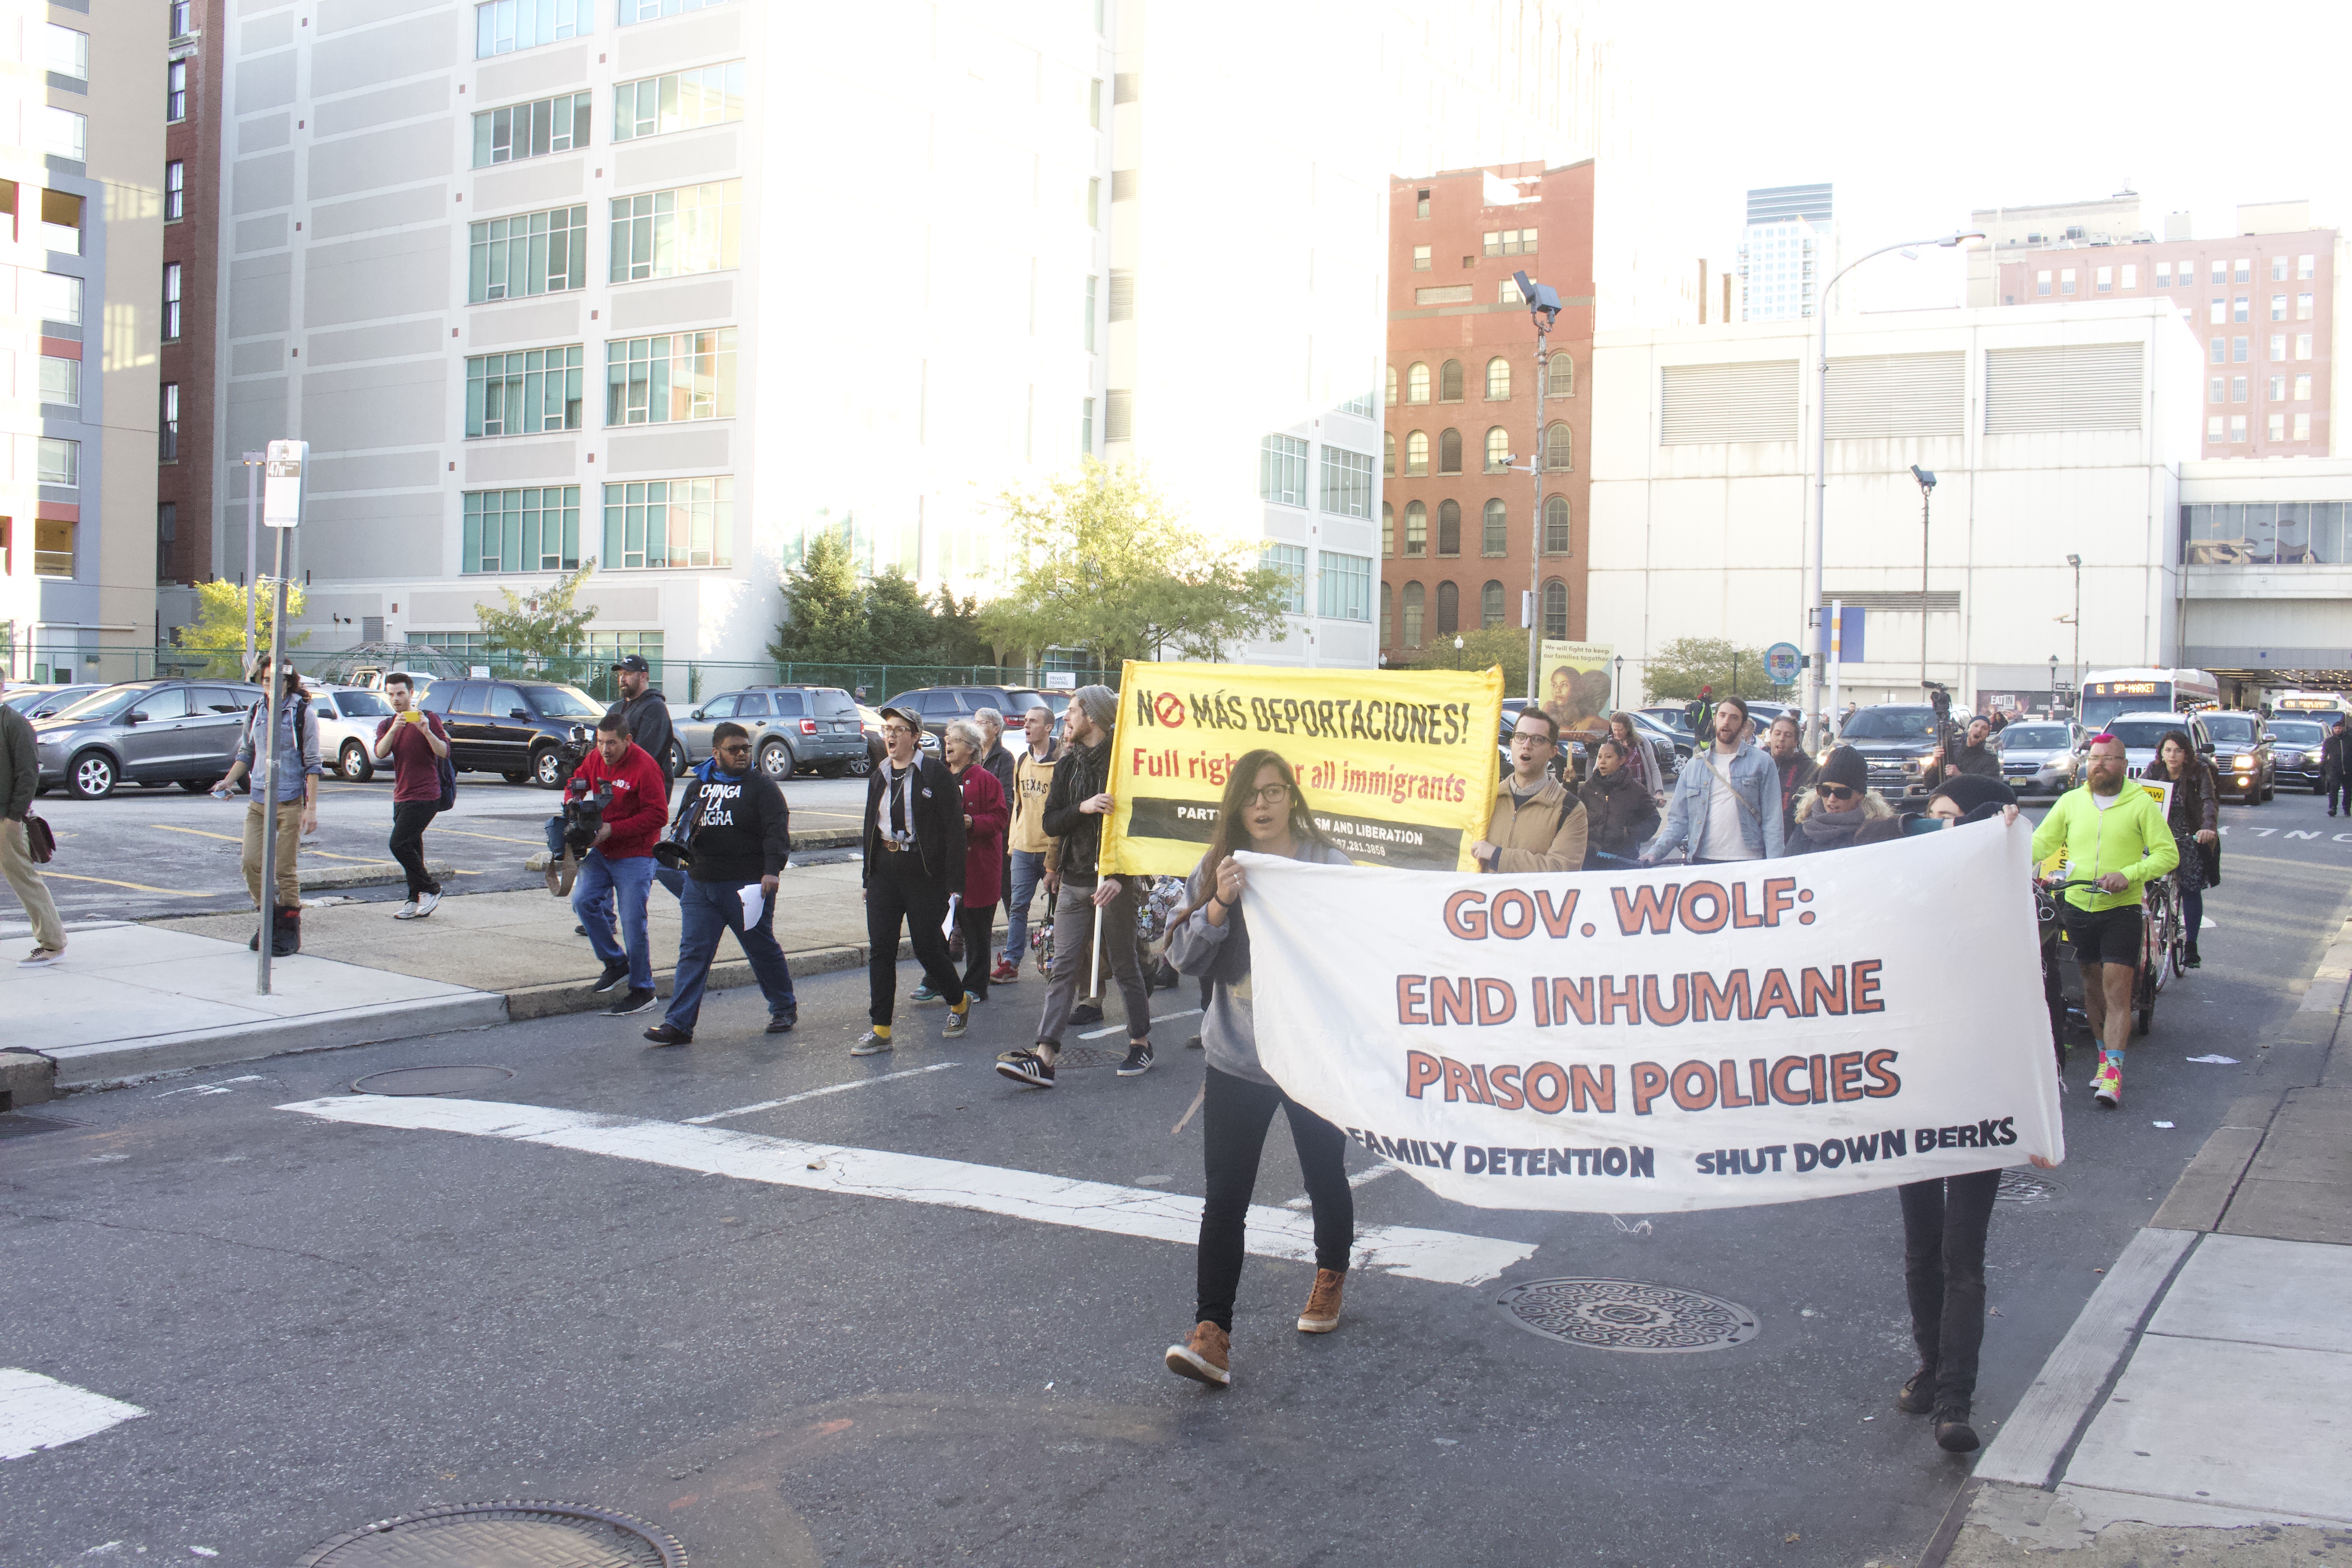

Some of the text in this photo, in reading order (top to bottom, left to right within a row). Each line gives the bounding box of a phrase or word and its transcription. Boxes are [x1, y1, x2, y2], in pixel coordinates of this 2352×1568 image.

[269, 461, 285, 476] 47M
[1991, 696, 2013, 705] EAT IN
[2096, 683, 2155, 694] 61 9TH-MARKET
[1190, 689, 1247, 730] MÁS
[1251, 697, 1470, 745] DEPORTACIONES!
[1020, 779, 1048, 794] TEXAS
[1133, 748, 1179, 777] Full
[1189, 750, 1238, 786] righ
[1311, 760, 1335, 790] all
[1341, 760, 1466, 804] immigrants
[700, 784, 741, 799] CHINGA
[706, 797, 722, 811] LA
[1333, 820, 1353, 835] AND
[1356, 823, 1423, 845] LIBERATION
[1442, 876, 1816, 941] GOV. WOLF:
[1396, 958, 1885, 1027] END INHUMANE
[1405, 1048, 1901, 1116] PRISON POLICIES
[1345, 1116, 2018, 1178] FAMILY DETENTION SHUT DOWN BERKS
